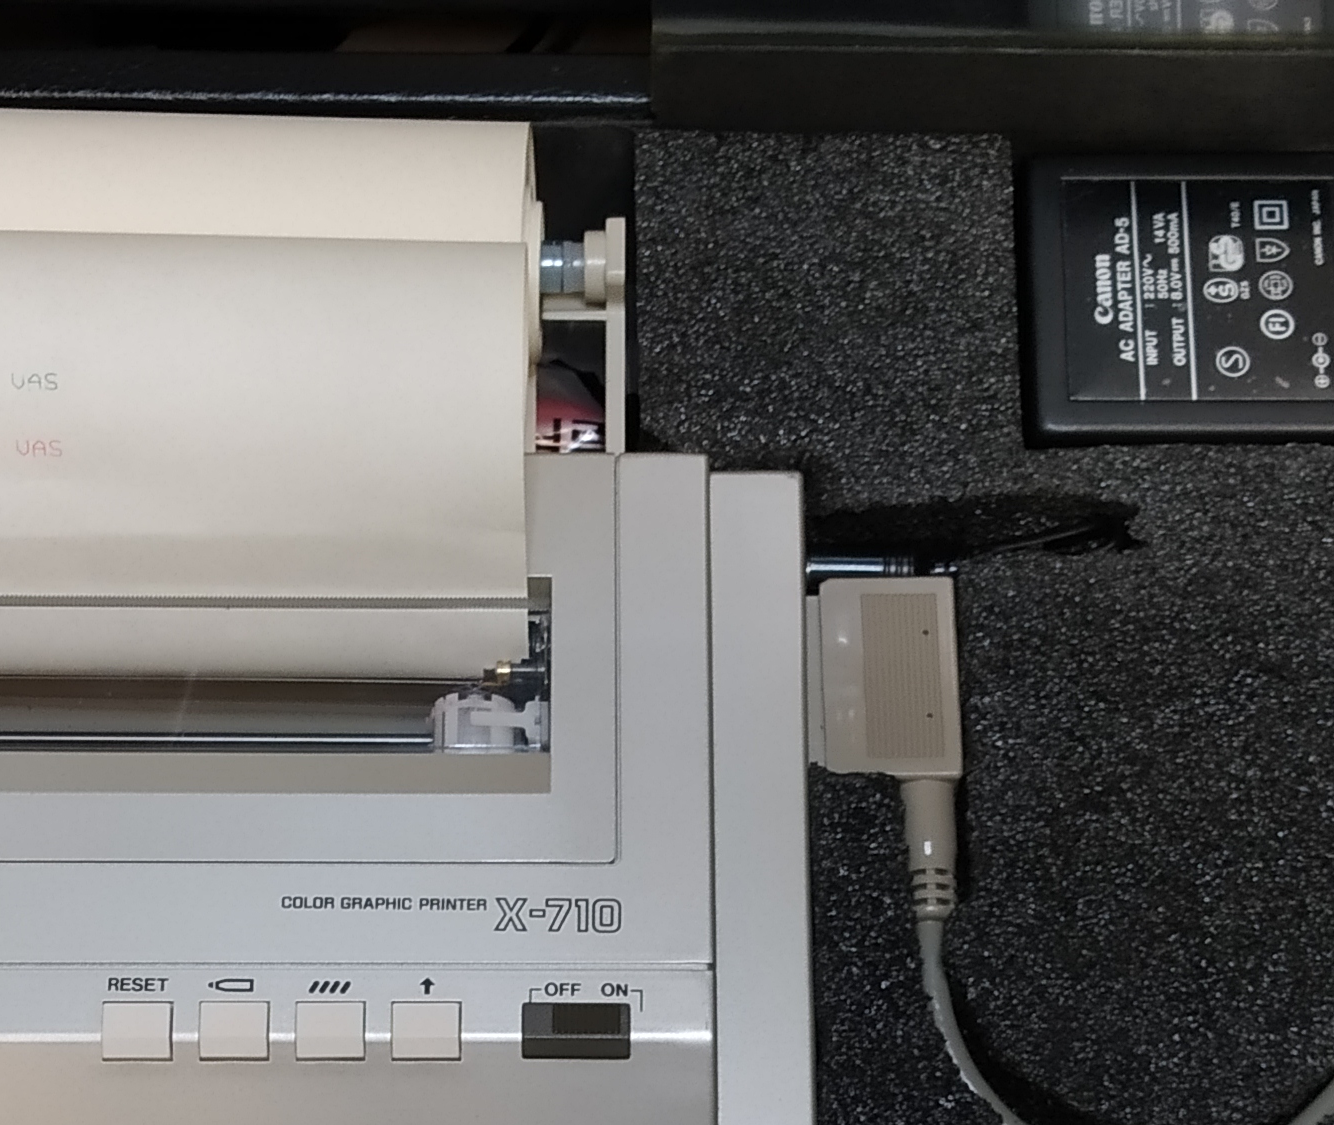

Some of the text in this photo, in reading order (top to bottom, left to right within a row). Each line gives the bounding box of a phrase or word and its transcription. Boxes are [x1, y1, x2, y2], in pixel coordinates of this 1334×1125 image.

[1167, 212, 1180, 255] 500mA
[1094, 254, 1114, 325] Canon
[1116, 261, 1134, 332] ADAPTER
[1156, 269, 1169, 300] 50Hz
[1119, 338, 1135, 362] AC
[1144, 329, 1158, 366] INPUT
[1171, 317, 1187, 366] OUTPUT
[10, 372, 59, 391] VAS
[16, 439, 63, 457] VAS
[281, 896, 622, 933] COLOR GRAPHIC PRINTER X-710
[107, 977, 169, 993] RESET
[544, 982, 629, 997] OFF ON
